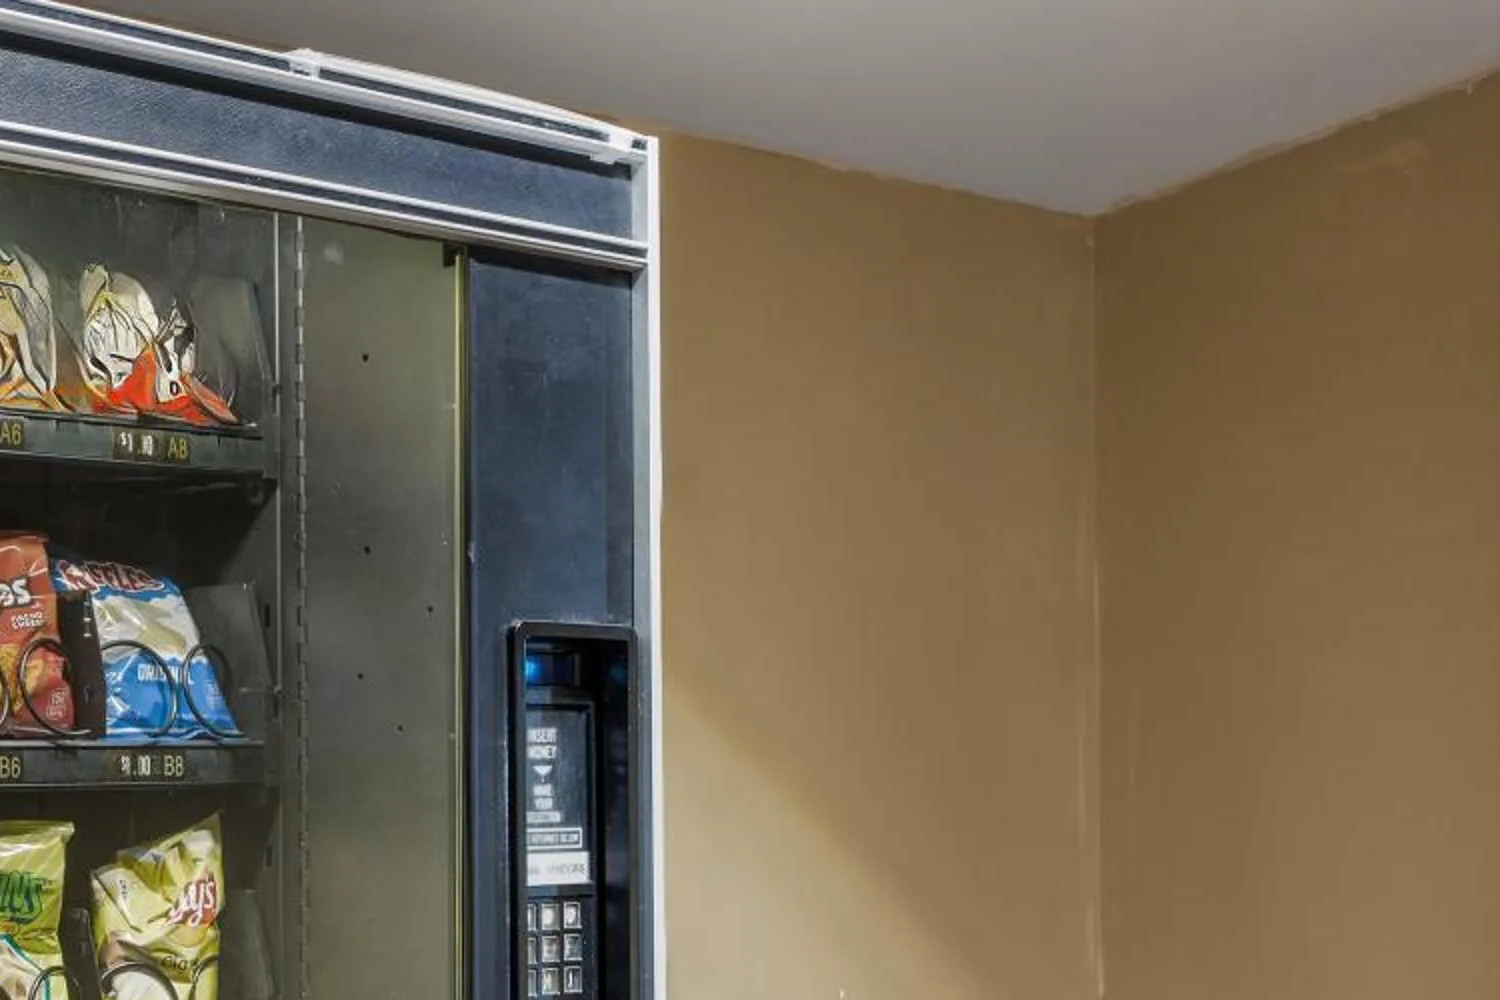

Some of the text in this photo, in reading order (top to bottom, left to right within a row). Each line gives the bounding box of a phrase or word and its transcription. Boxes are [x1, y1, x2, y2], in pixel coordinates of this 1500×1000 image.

[0, 421, 21, 444] A6
[167, 437, 188, 459] A8
[0, 756, 21, 779] B6
[164, 755, 184, 777] B8
